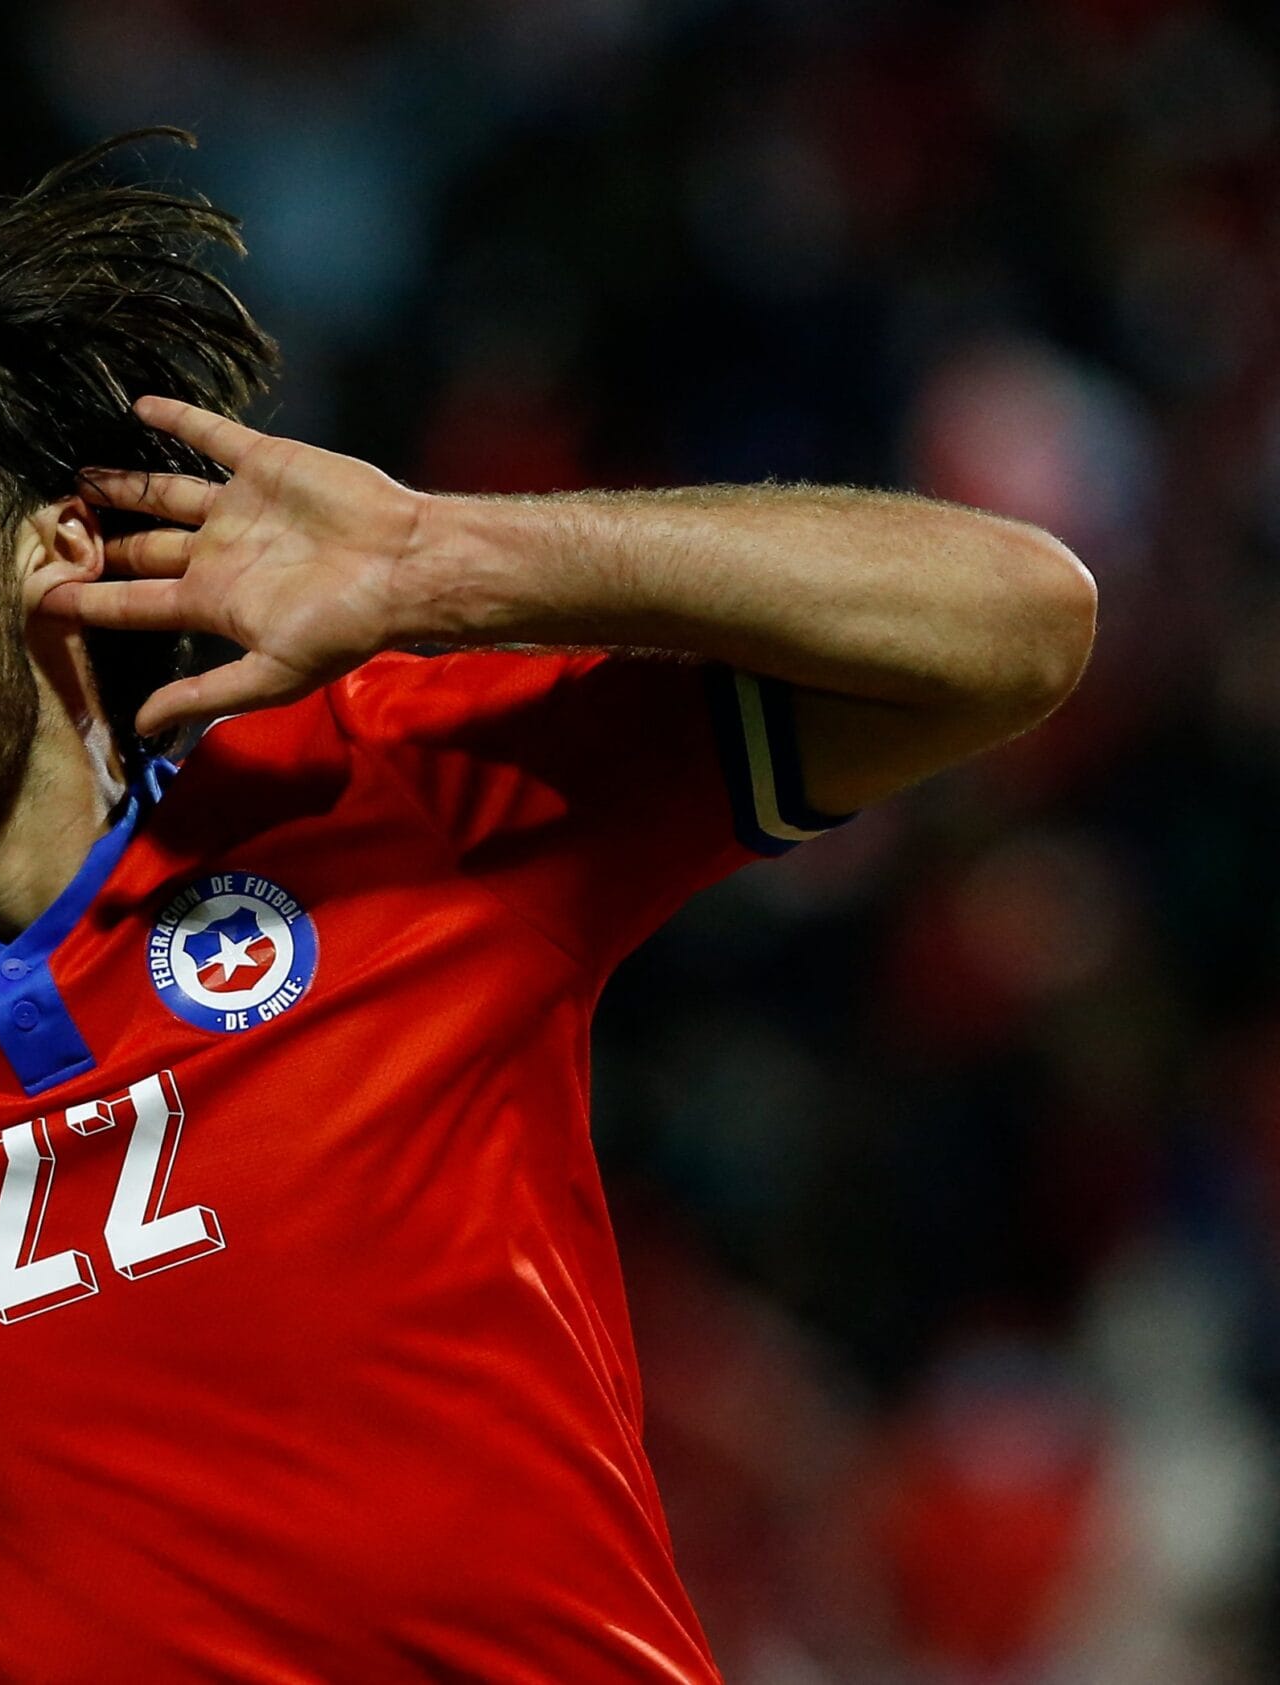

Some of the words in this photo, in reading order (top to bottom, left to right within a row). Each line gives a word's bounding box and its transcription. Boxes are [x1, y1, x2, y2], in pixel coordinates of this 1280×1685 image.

[150, 887, 202, 990] FEDERACION
[211, 875, 233, 894] DE
[244, 876, 302, 924] FUTBOL
[225, 1011, 249, 1030] DE
[258, 979, 303, 1022] CHILE
